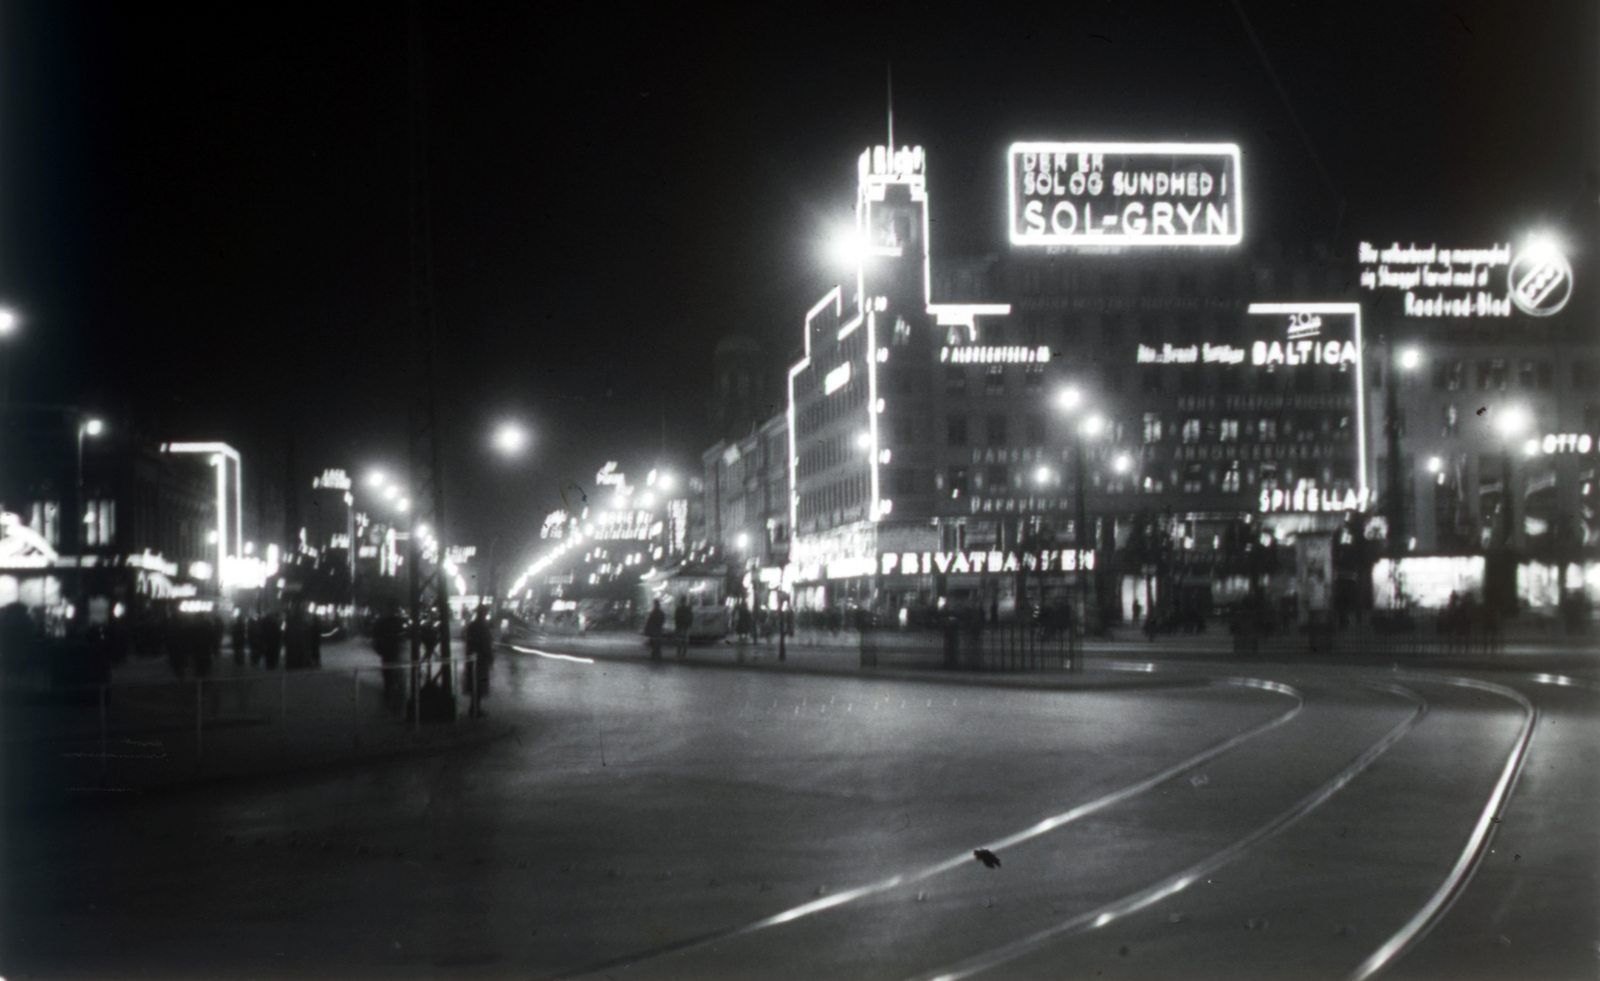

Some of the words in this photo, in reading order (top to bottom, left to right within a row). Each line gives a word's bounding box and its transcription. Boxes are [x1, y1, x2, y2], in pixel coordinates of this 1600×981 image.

[1023, 152, 1067, 172] DER
[1078, 152, 1104, 172] ER
[1023, 171, 1066, 196] SOL
[1112, 171, 1214, 197] SUNDHED
[1024, 200, 1229, 236] SOL-GRYN
[1251, 340, 1357, 366] BALTICA
[1542, 433, 1592, 454] OTTO
